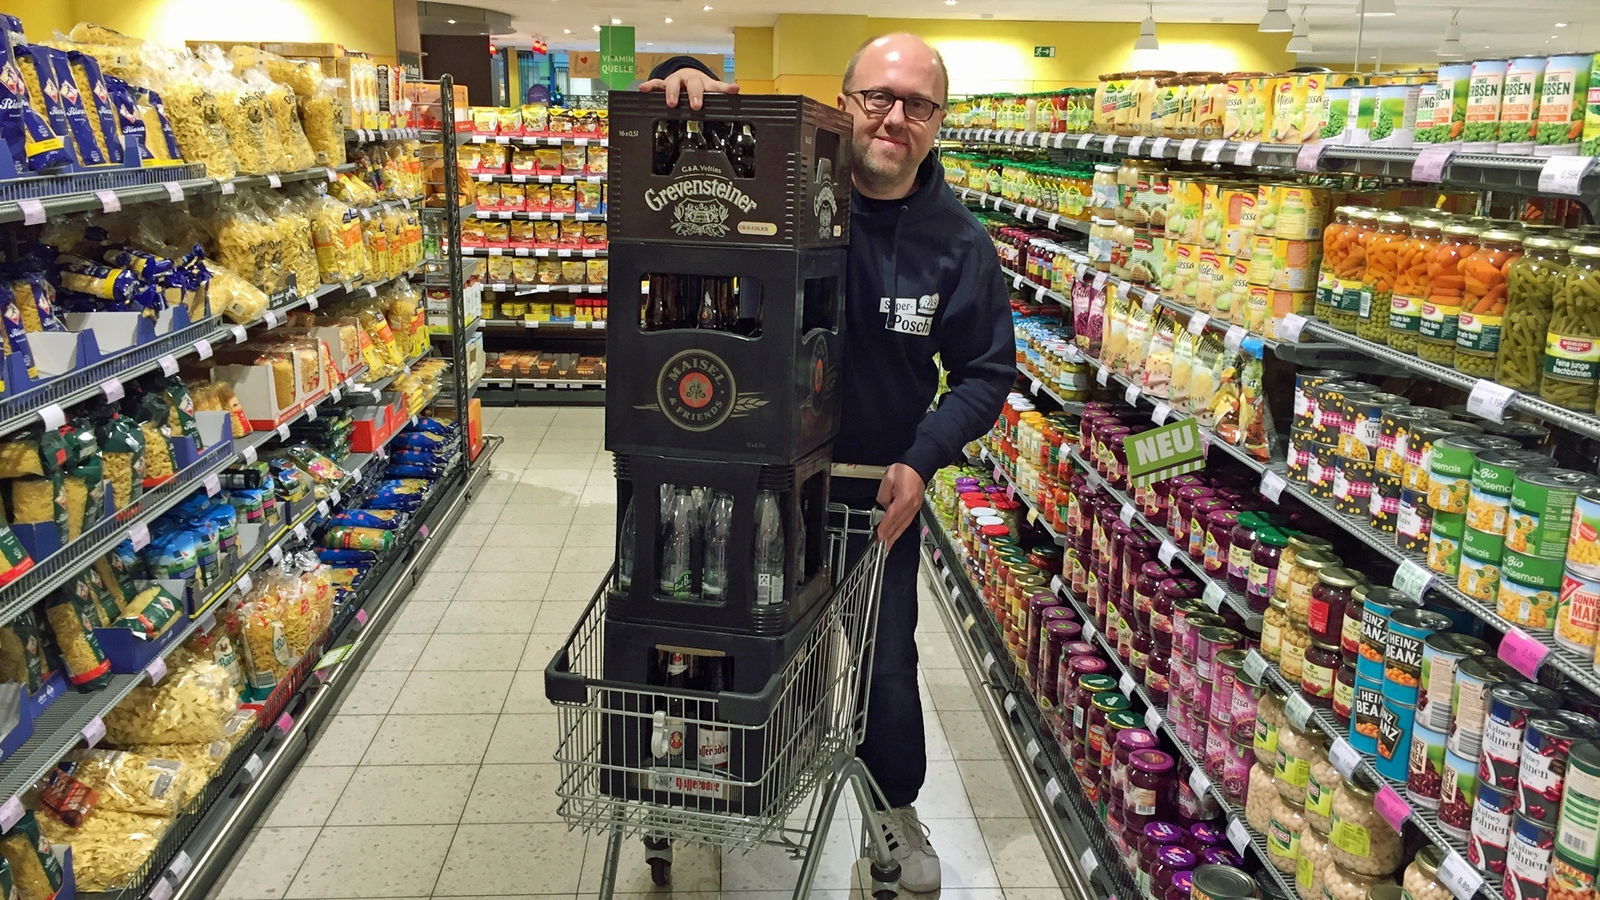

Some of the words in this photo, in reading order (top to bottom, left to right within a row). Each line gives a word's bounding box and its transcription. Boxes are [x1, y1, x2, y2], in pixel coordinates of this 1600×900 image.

[602, 64, 634, 73] QUELLE
[1543, 82, 1570, 95] RBSEN
[644, 178, 758, 214] Grevensteiner
[884, 300, 912, 313] Sper-
[668, 358, 724, 386] MAISEL
[1556, 358, 1570, 368] Feine
[1570, 361, 1590, 370] junge
[675, 400, 724, 421] FRIENDS
[1134, 424, 1194, 466] NEU
[1480, 468, 1498, 479] Bio
[1507, 556, 1524, 568] Bio
[1574, 592, 1600, 608] SONNE
[1361, 622, 1388, 645] EANZ
[1388, 632, 1420, 652] HEINZ
[1386, 644, 1422, 666] BEANZ
[1356, 700, 1379, 718] BEA
